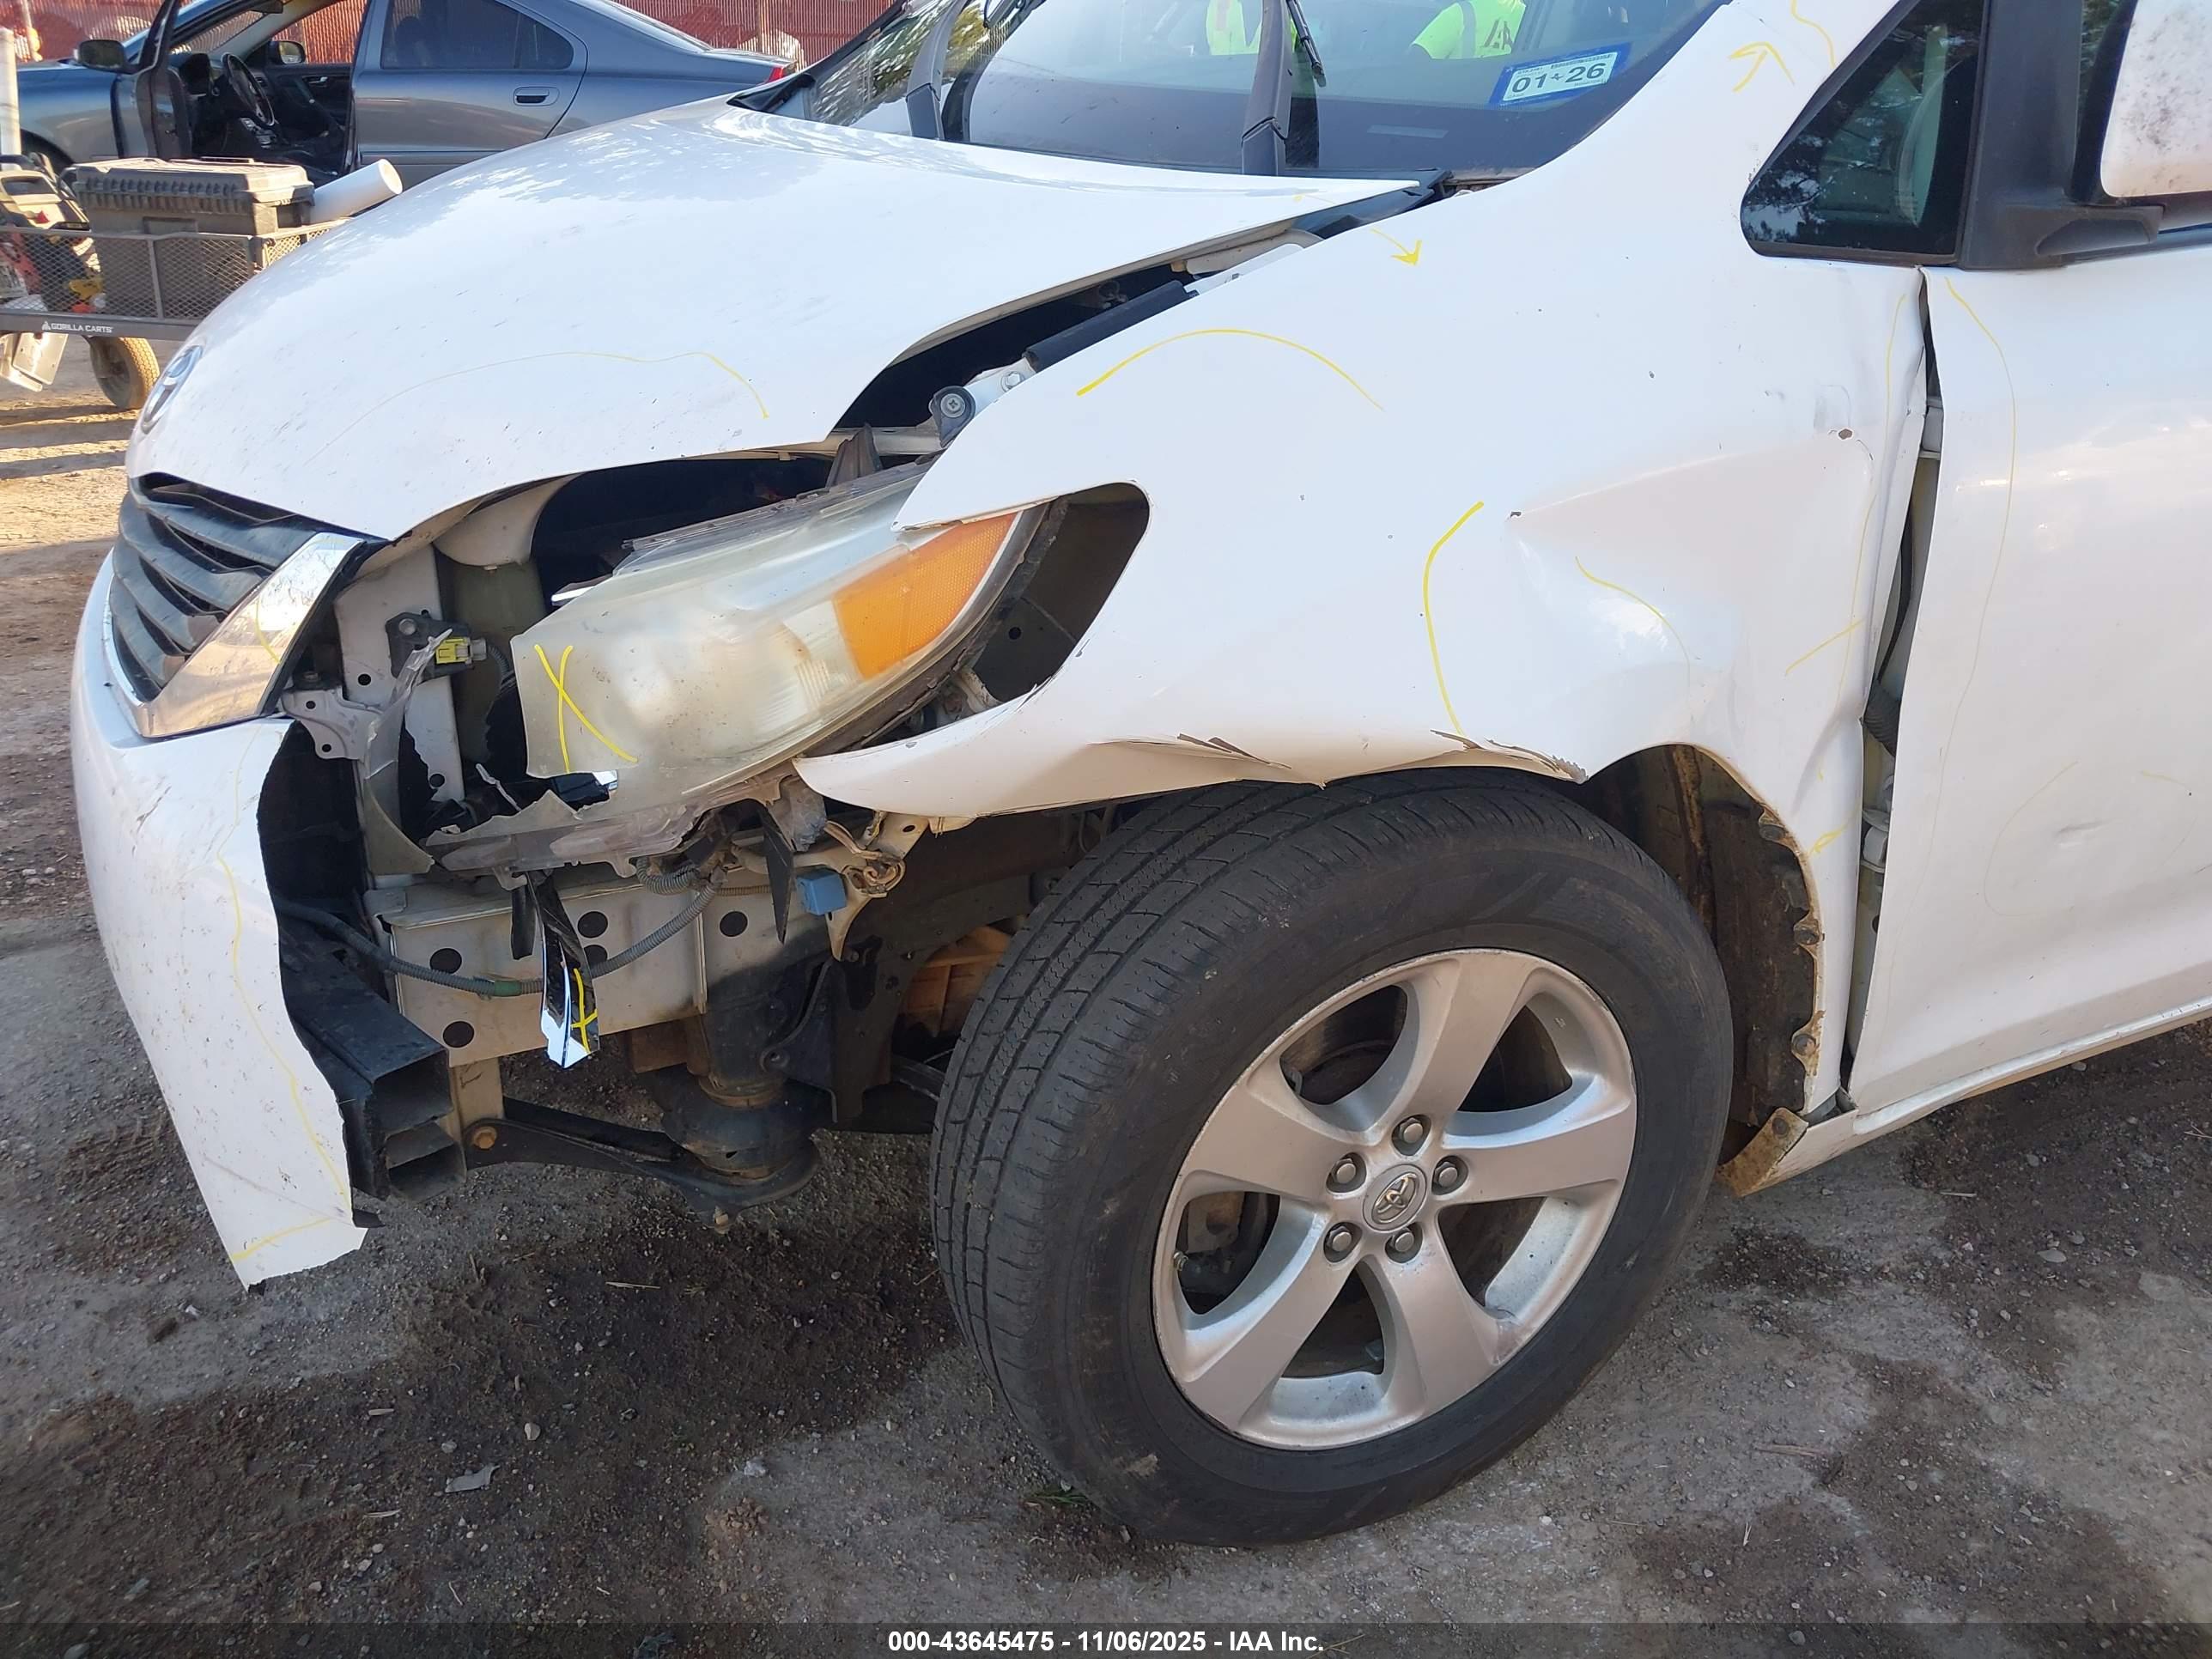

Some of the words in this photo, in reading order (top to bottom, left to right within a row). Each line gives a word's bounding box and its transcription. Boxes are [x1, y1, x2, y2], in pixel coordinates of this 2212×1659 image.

[1511, 74, 1547, 93] 01
[1565, 63, 1607, 83] 26
[51, 323, 84, 331] GORILLA
